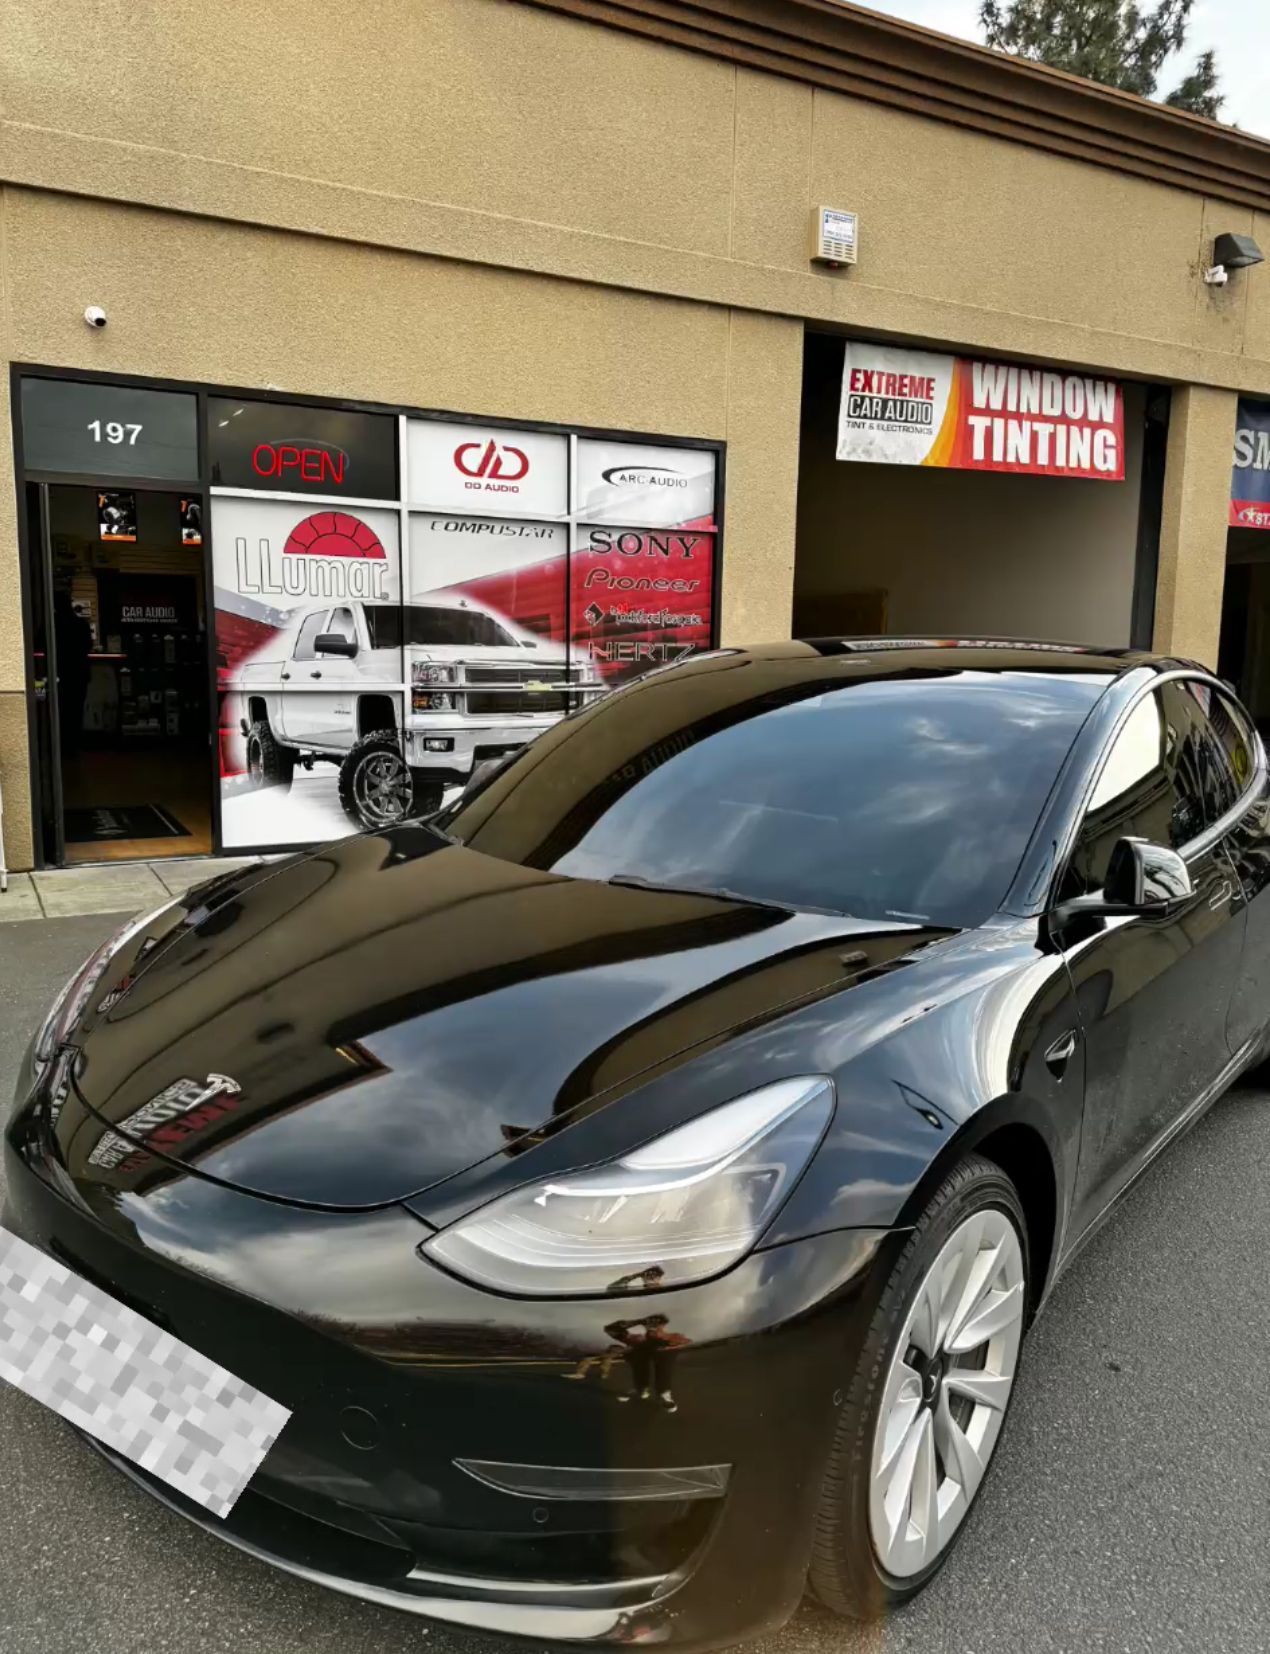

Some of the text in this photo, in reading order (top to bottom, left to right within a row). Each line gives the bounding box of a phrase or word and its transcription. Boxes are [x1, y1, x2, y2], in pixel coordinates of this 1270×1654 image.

[850, 368, 935, 400] EXTREME
[972, 362, 1116, 423] WINDOW
[849, 396, 932, 423] CAR AUDIO
[87, 419, 143, 445] 197
[847, 420, 866, 430] TINT
[877, 424, 933, 436] ELECTRONICS
[968, 415, 1117, 472] TINTING
[252, 444, 345, 485] OPEN
[485, 483, 520, 493] AUDIO
[619, 473, 688, 488] ARC AUDIO
[430, 520, 554, 540] COMPUSTAR
[589, 530, 700, 559] SONY
[235, 536, 389, 600] LLumar
[584, 566, 700, 592] Pioneer
[121, 606, 176, 618] CAR AUDIO
[588, 641, 696, 661] HERTZ
